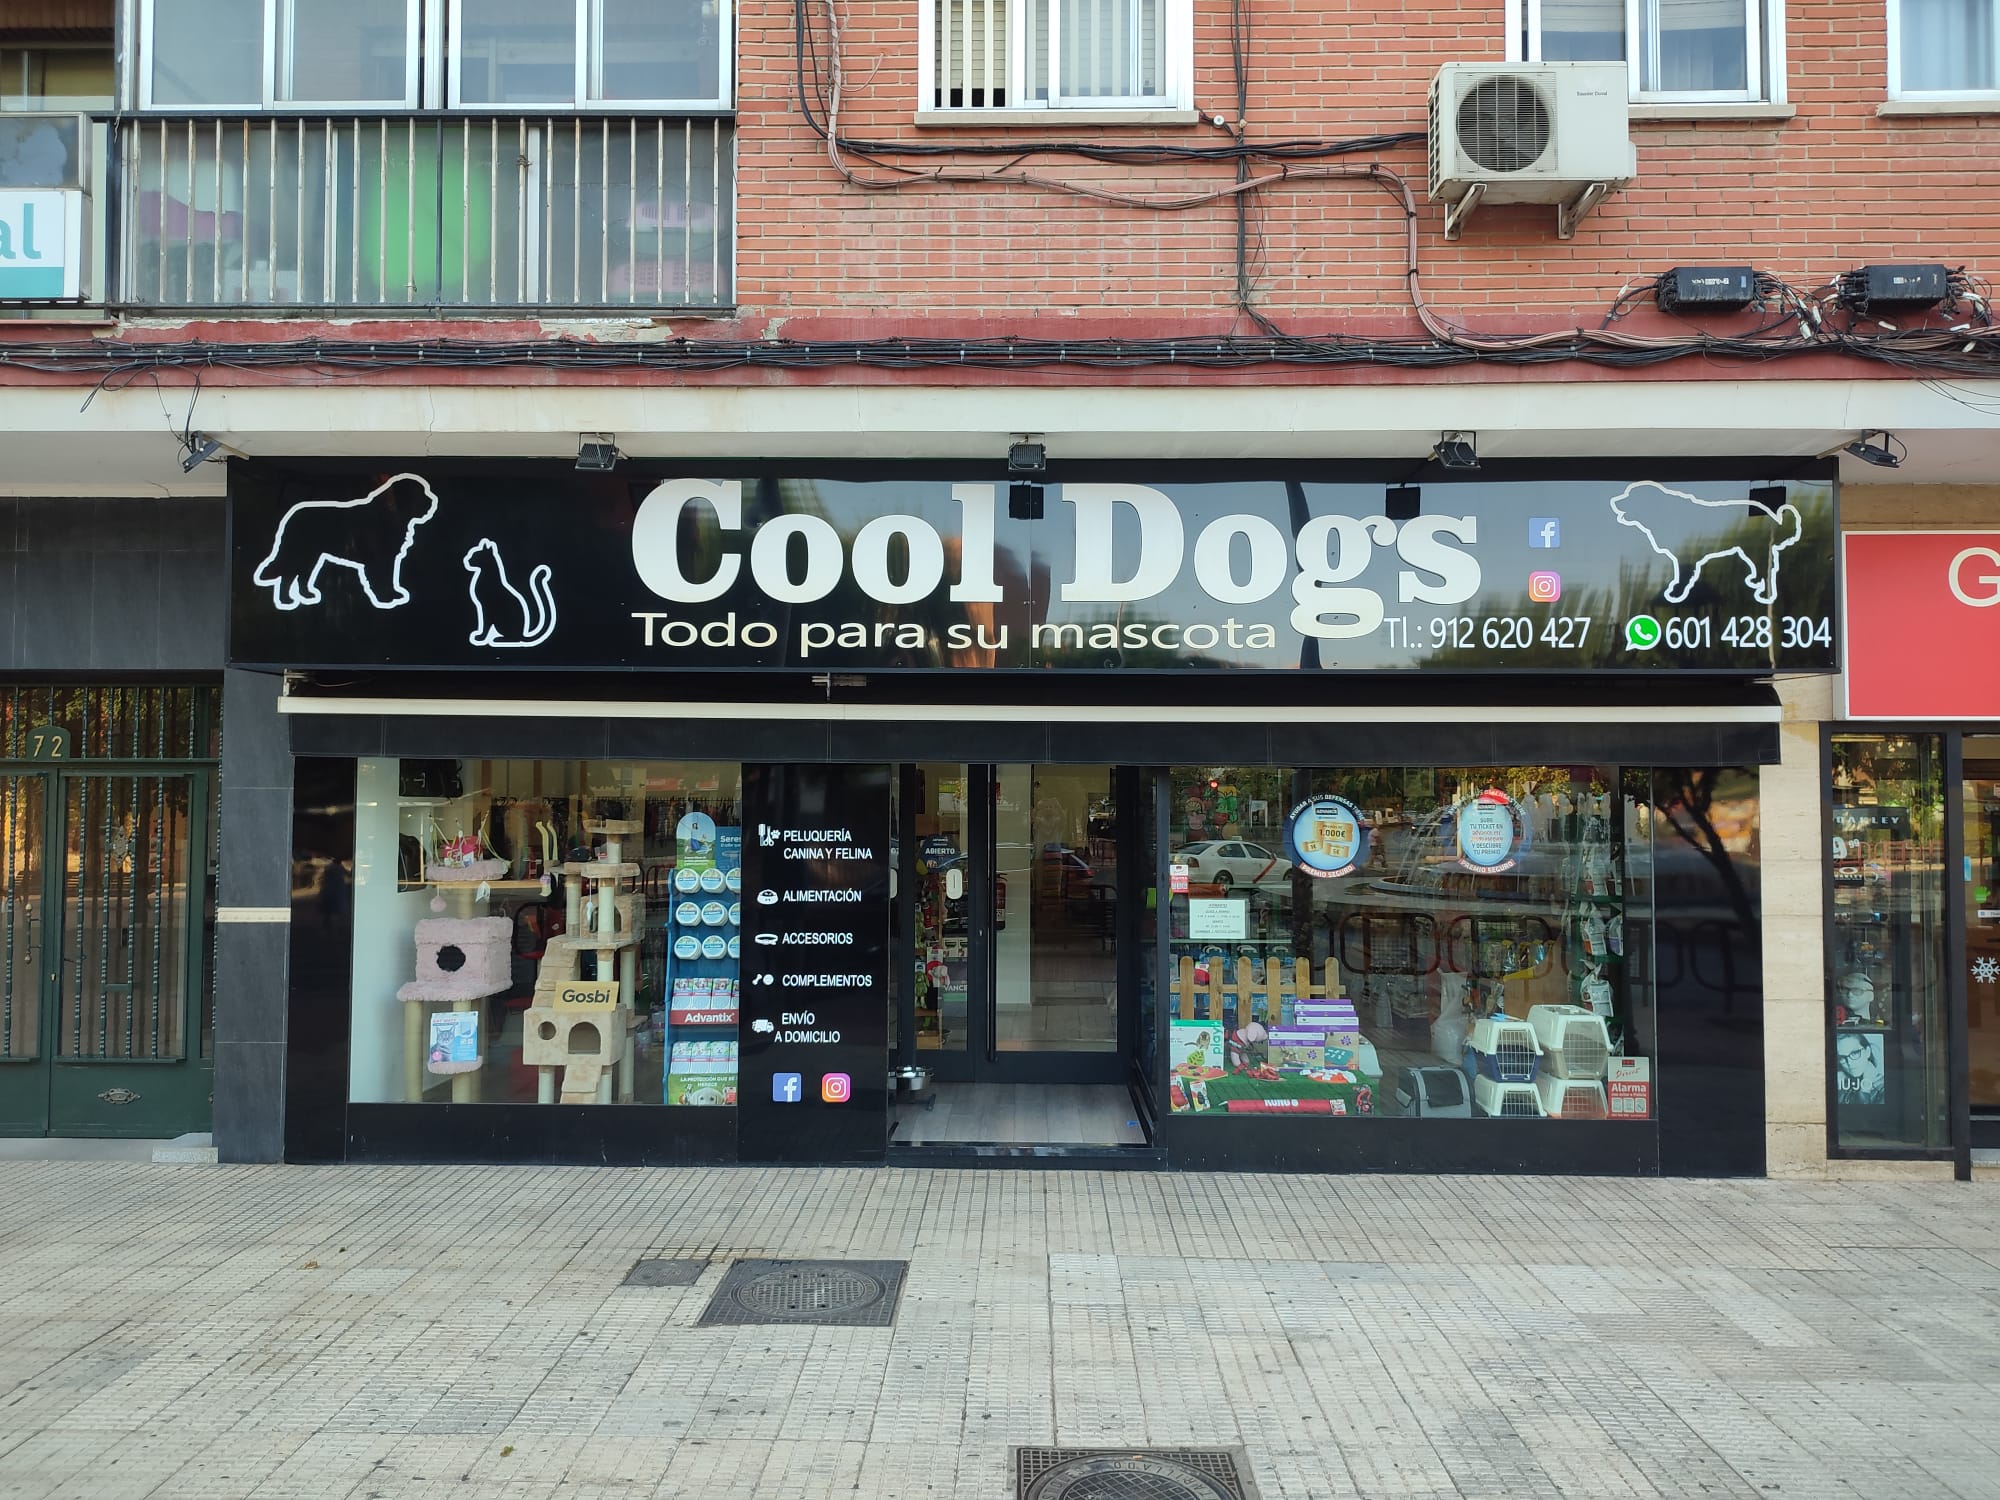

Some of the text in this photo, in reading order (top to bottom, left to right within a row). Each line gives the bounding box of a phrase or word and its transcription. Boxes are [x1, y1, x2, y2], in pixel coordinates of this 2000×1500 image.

[632, 478, 1482, 639] Cool Dogs
[1948, 546, 2000, 607] G
[632, 612, 1276, 658] Todo para su mascota
[1384, 616, 1591, 648] Tl.: 912 620 427
[1665, 616, 1832, 649] 601 428 304
[33, 735, 63, 757] 72
[784, 828, 852, 842] PELUQUERÍA
[784, 848, 872, 859] CANINA Y FELINA
[925, 847, 955, 855] ABIERTO
[1302, 863, 1327, 878] PREMIO
[1460, 859, 1487, 873] PREMIO
[783, 888, 862, 902] ALIMENTACIÓN
[782, 932, 853, 944] ACCESORIOS
[782, 975, 872, 987] COMPLEMENTOS
[562, 989, 611, 1003] Gosbi
[782, 1010, 815, 1025] ENVÍO
[774, 1031, 841, 1043] A DOMICILIO
[1212, 1026, 1224, 1055] play
[1612, 1083, 1646, 1092] Alarma
